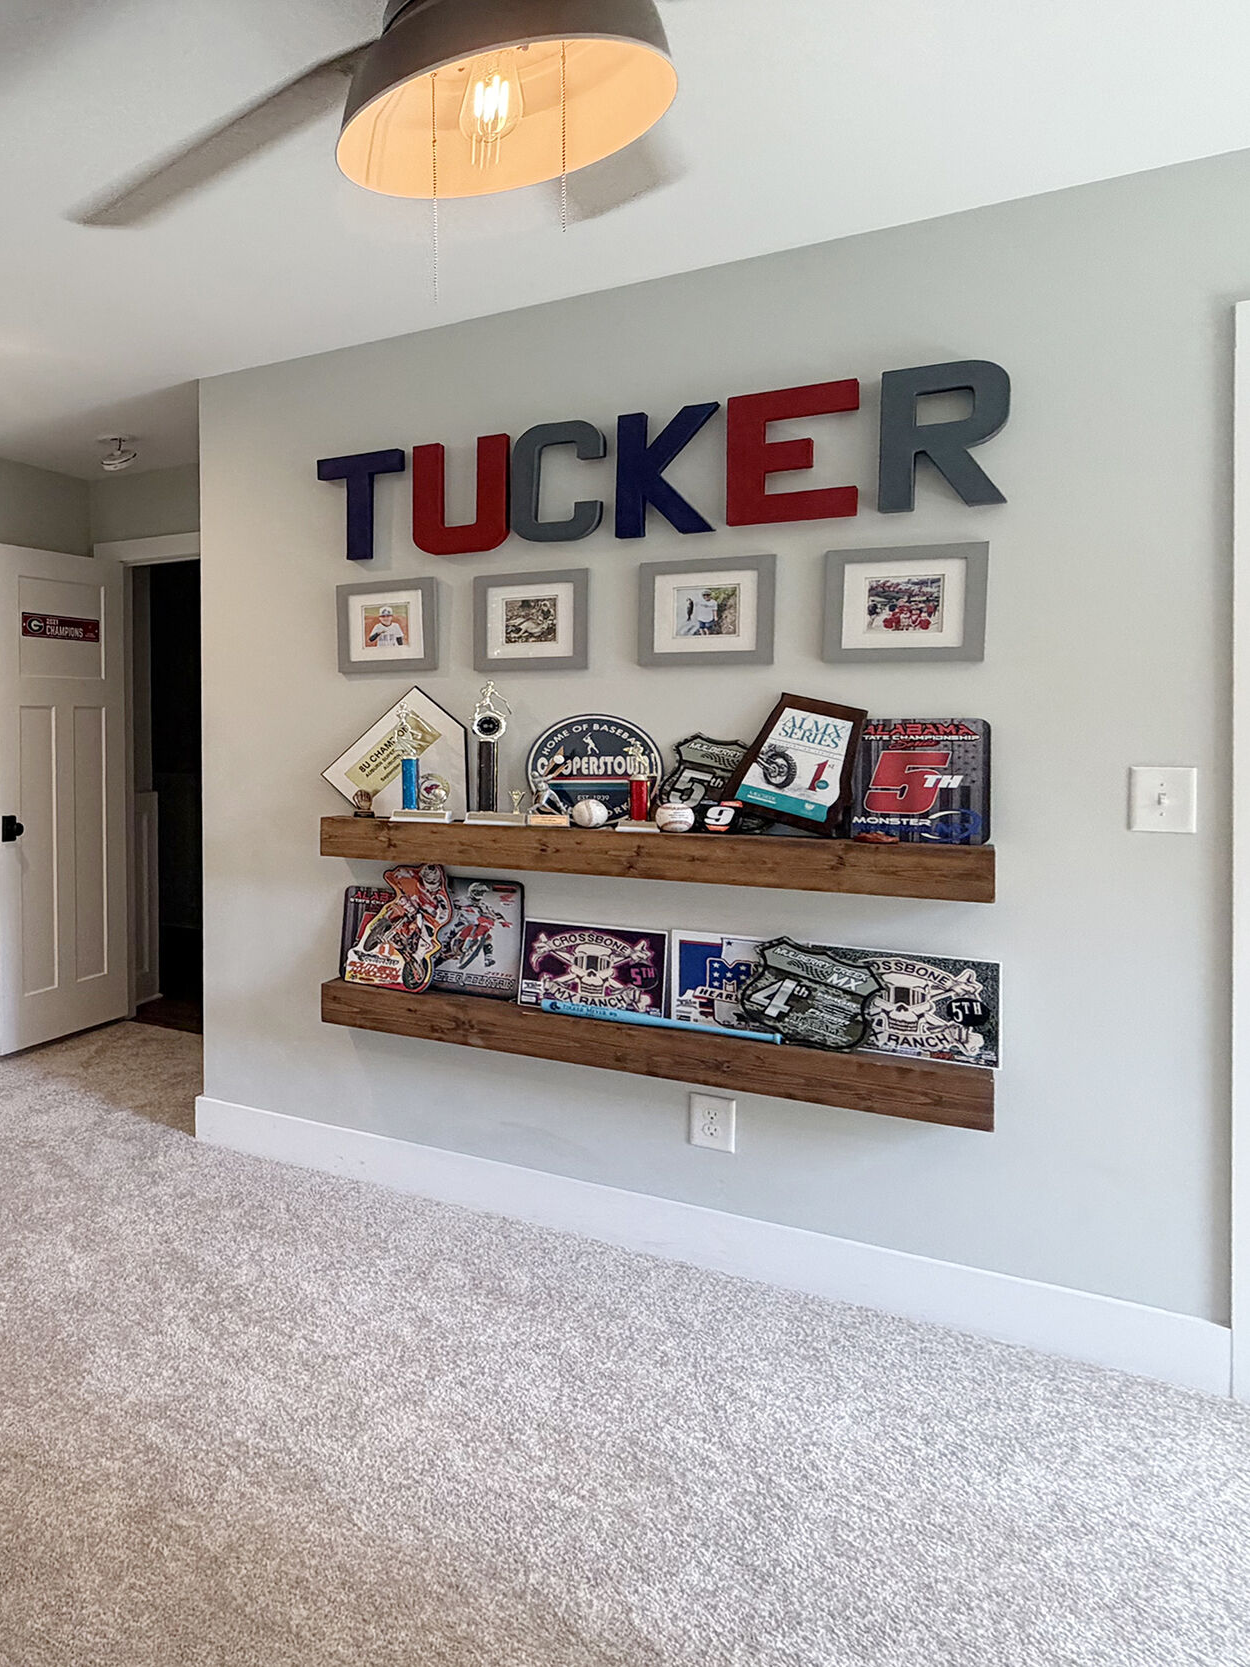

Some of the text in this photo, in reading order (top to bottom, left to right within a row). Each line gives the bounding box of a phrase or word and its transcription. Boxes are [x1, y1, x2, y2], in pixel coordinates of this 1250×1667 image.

[316, 359, 1011, 561] TUCKER
[46, 625, 84, 638] CHAMPIONS
[782, 715, 846, 739] ALMX
[864, 723, 978, 735] ALABAMA
[542, 723, 638, 755] HOME OF BASEBA
[778, 726, 839, 749] SERIES
[704, 806, 735, 825] 9
[852, 816, 932, 826] MONSTER
[552, 933, 629, 954] CROSSBONE
[774, 947, 869, 981] MULBERRY CREEK
[871, 960, 950, 986] OSSBONE
[630, 967, 655, 986] 5TH
[827, 973, 867, 991] MX
[555, 988, 576, 1002] MX
[580, 994, 627, 1008] RANCH
[952, 1001, 982, 1022] 5TH
[888, 1034, 950, 1048] RANCH
